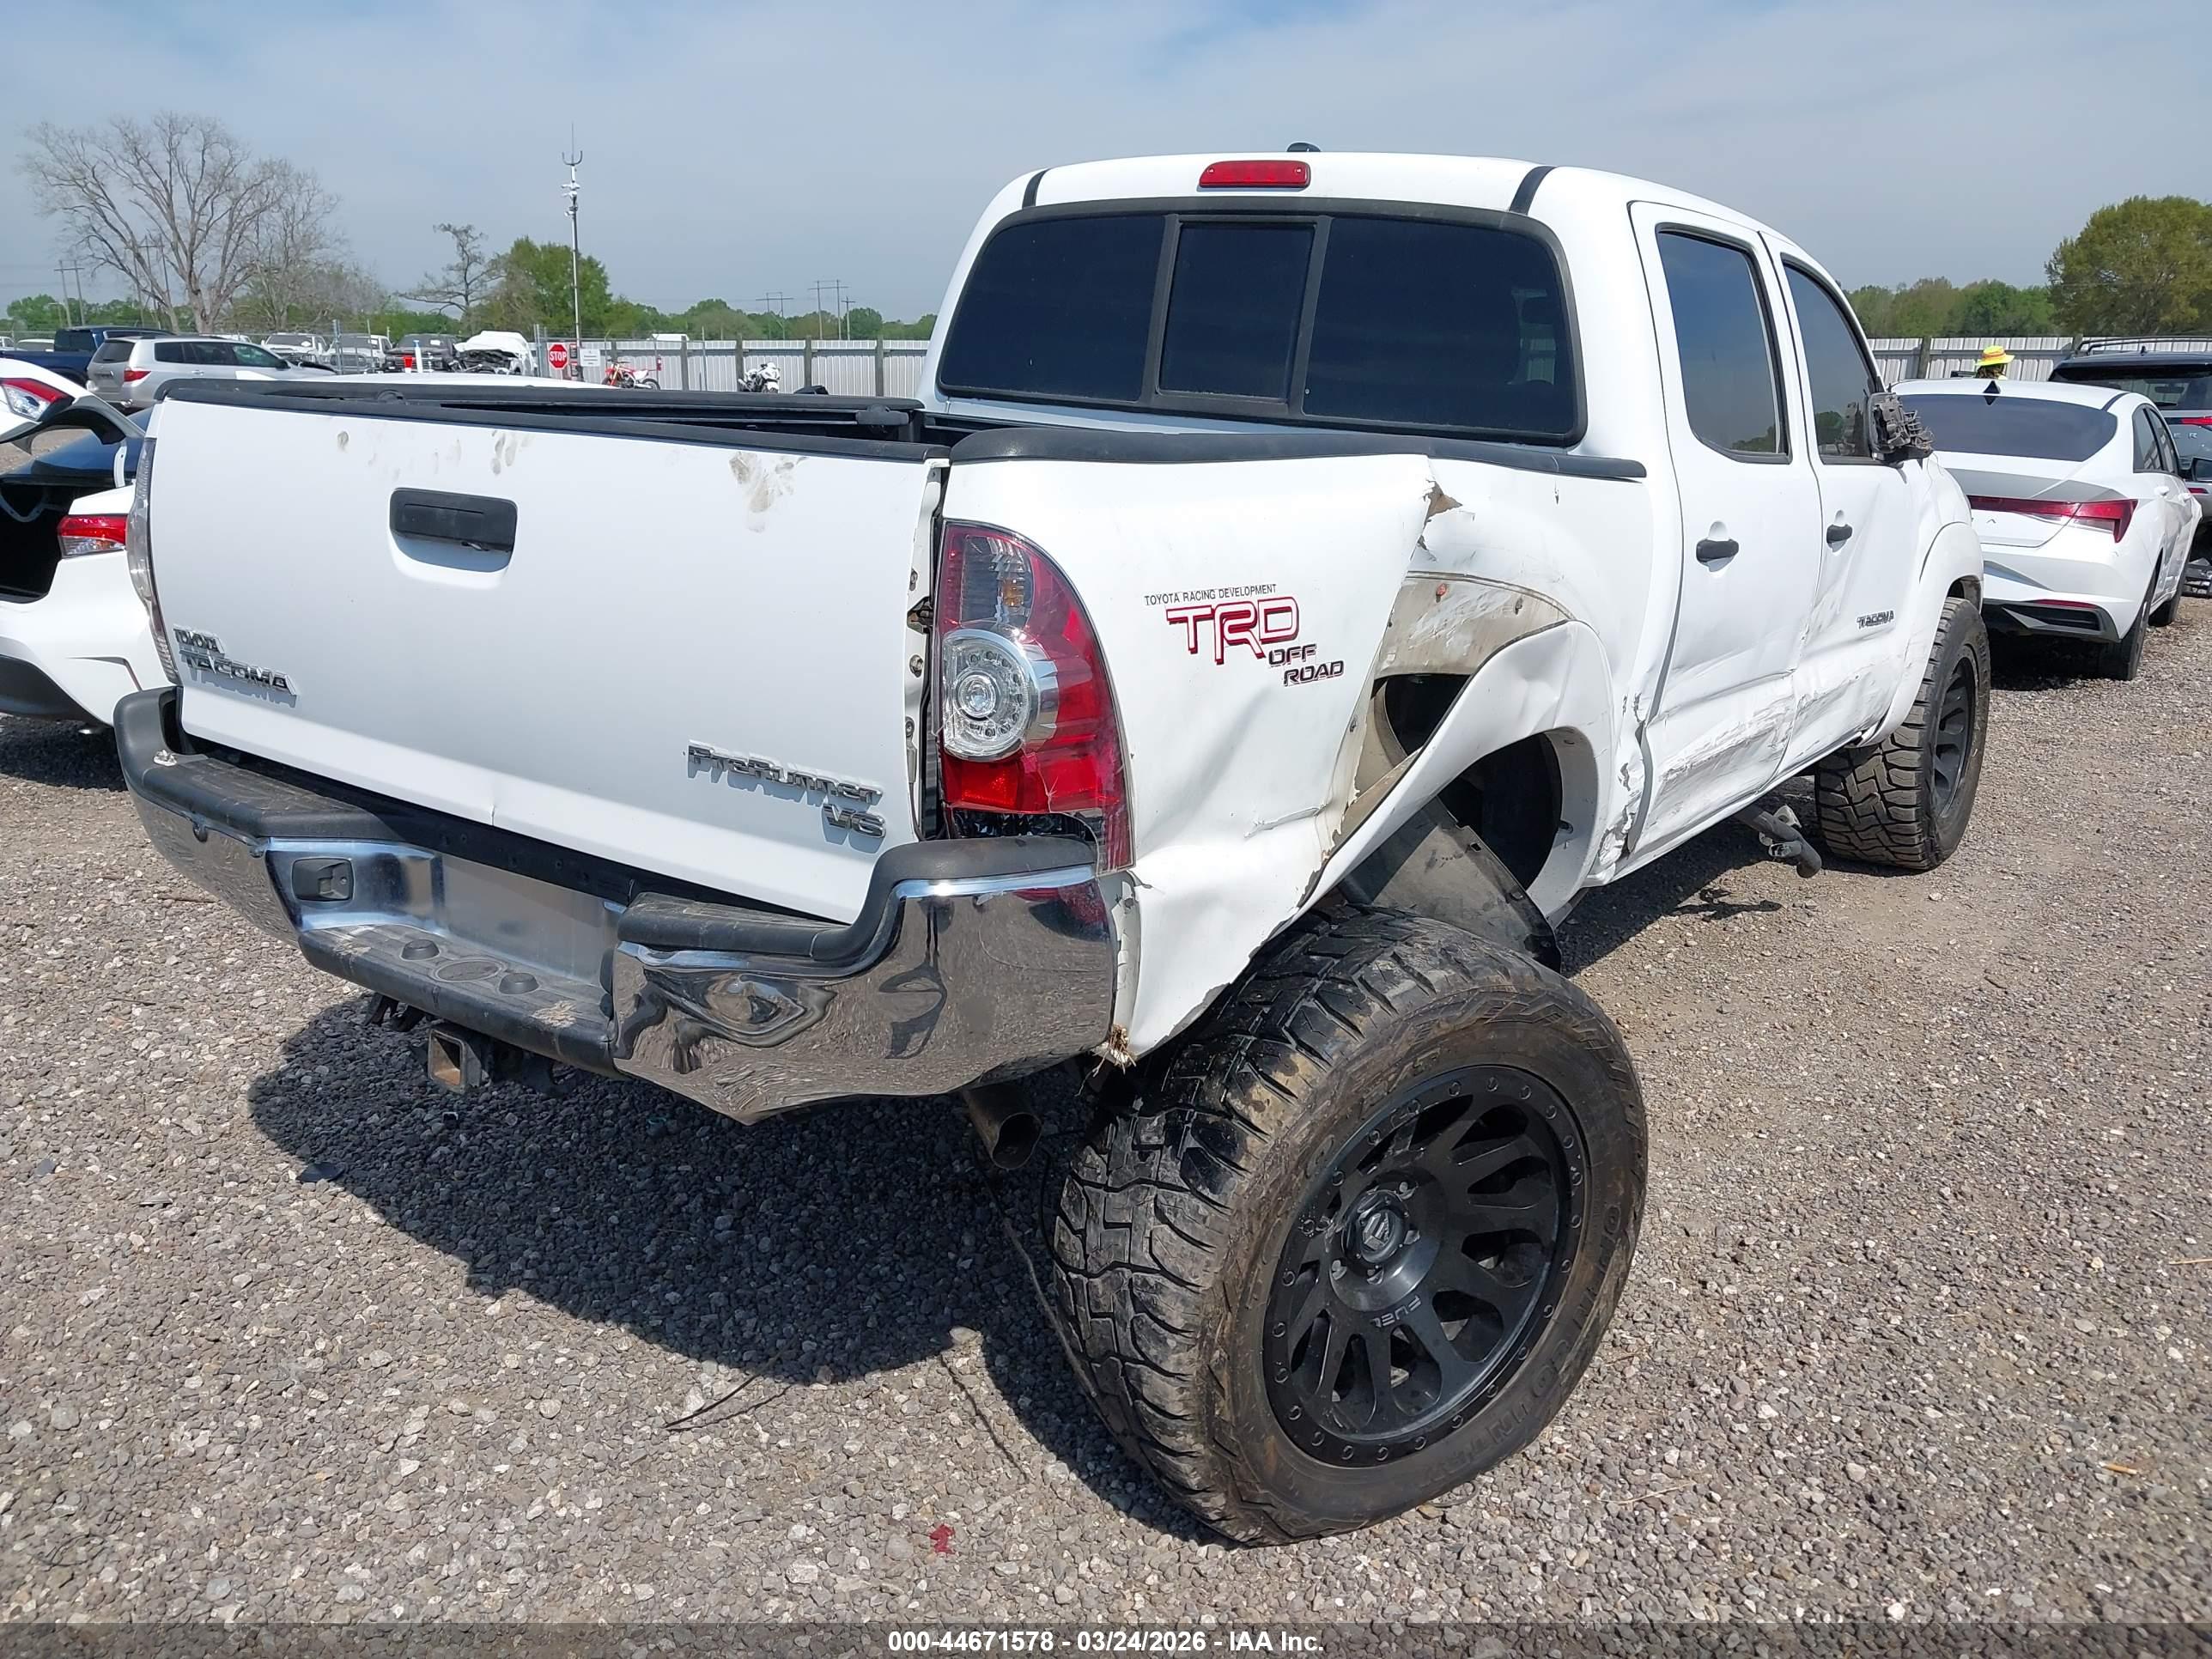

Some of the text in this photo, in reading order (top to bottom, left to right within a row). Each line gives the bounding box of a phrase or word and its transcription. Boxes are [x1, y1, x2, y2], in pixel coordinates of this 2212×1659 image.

[550, 350, 567, 362] STOP
[1145, 584, 1277, 605] TOYOTA RACING DEVELOPMENT
[1166, 597, 1298, 665] TRD
[1268, 643, 1316, 667] OFF
[1283, 659, 1344, 687] ROAD
[822, 803, 886, 838] V6
[1373, 1295, 1421, 1328] FUEL
